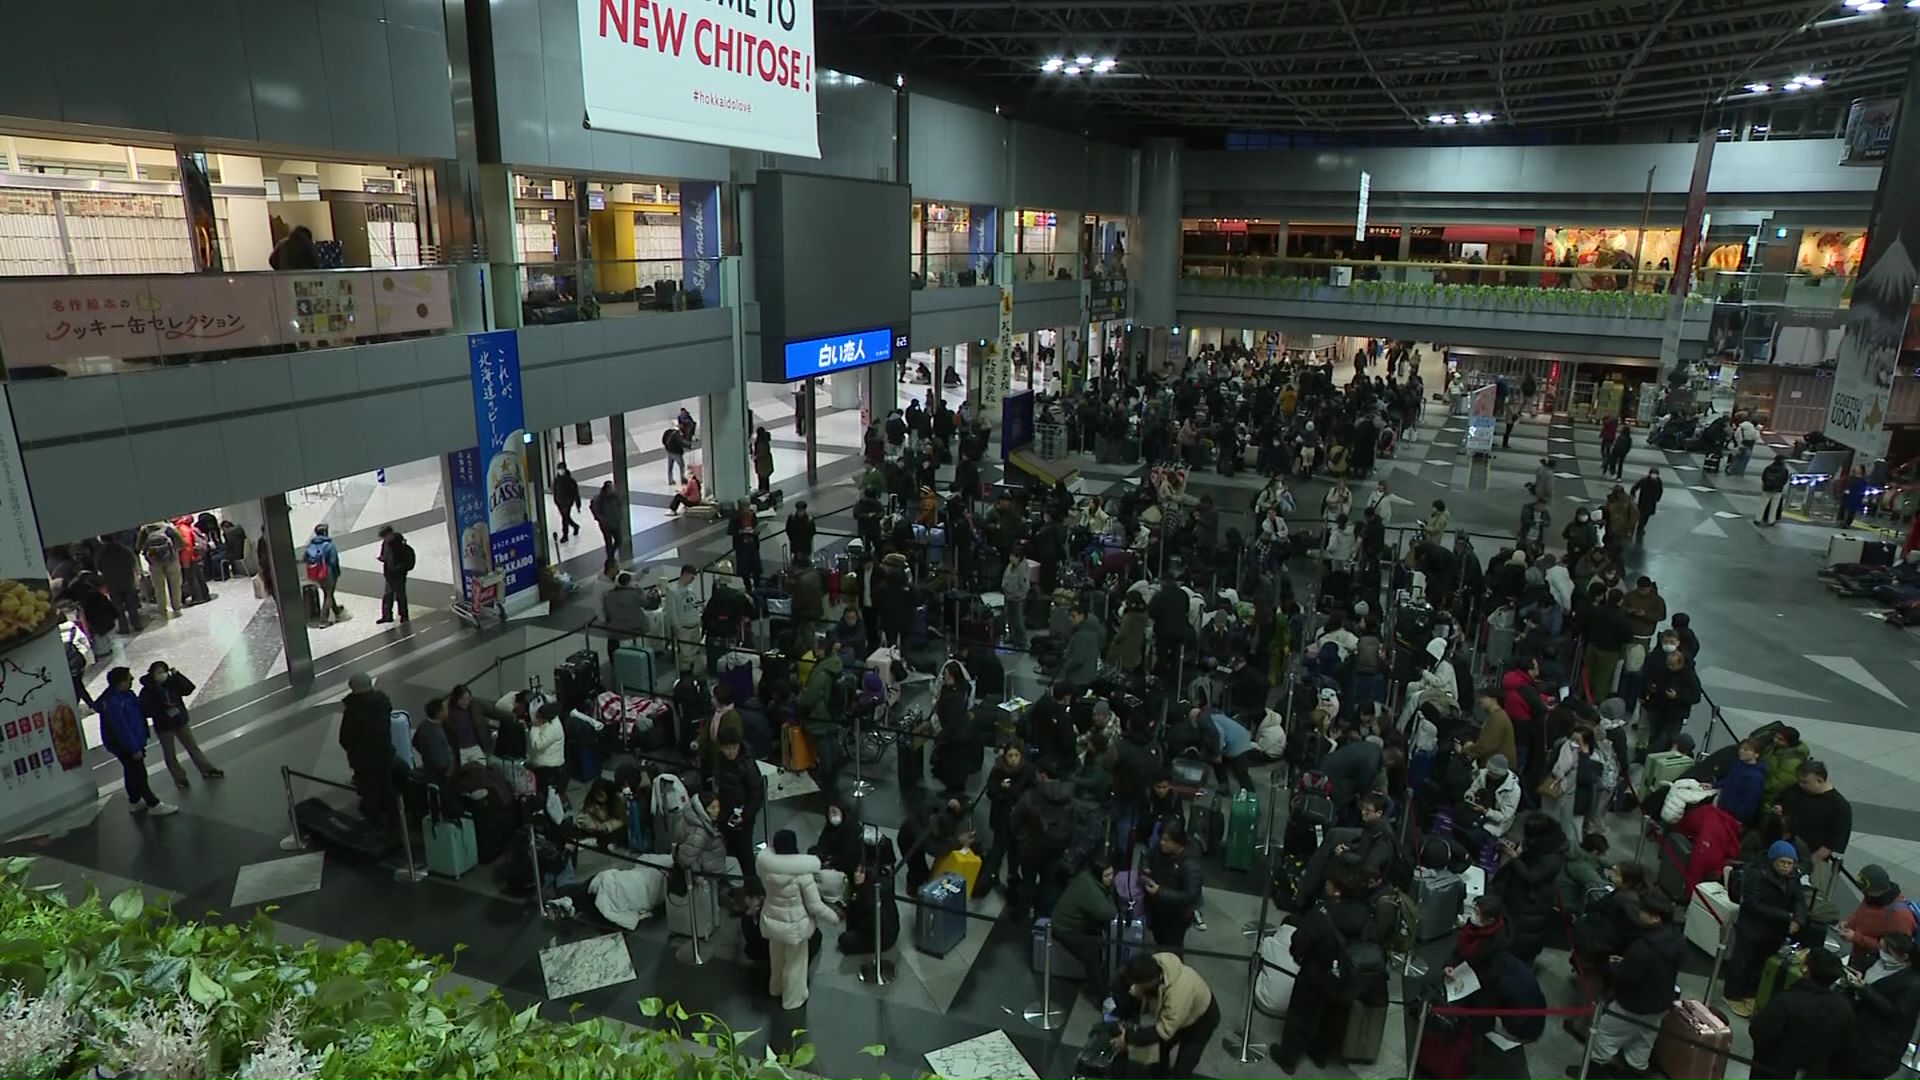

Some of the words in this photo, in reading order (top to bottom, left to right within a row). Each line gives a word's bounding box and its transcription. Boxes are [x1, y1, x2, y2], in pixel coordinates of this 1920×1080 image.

[599, 0, 688, 57] NEW
[692, 89, 752, 113] #hokkaidolove
[52, 298, 130, 312] 名作絵本の
[45, 313, 245, 341] クッキー缶セレクション
[818, 339, 866, 368] 白い恋人
[1831, 405, 1860, 432] UDON
[504, 554, 534, 573] KKAIDO
